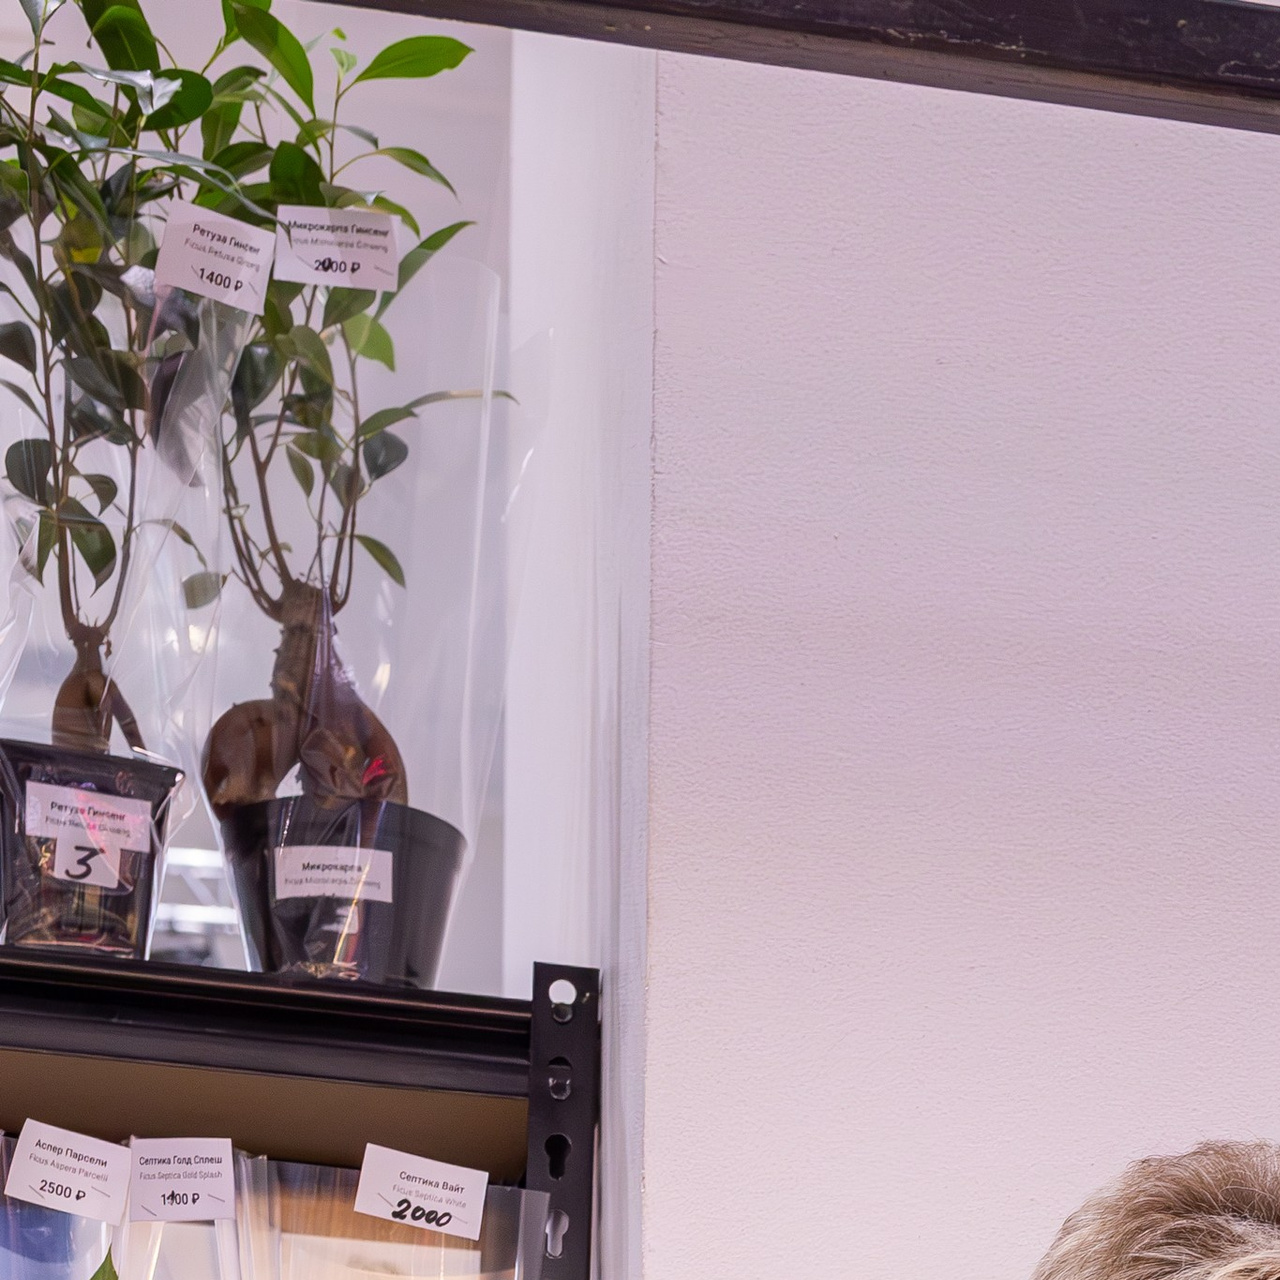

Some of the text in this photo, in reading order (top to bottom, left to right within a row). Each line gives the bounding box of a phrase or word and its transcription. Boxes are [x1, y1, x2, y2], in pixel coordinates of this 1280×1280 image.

[192, 223, 260, 255] Ретуза Гинсенг
[350, 224, 389, 237] Гинсенг
[199, 267, 231, 289] 1400
[65, 845, 103, 879] 3
[29, 1153, 49, 1165] Ficus
[50, 1160, 77, 1174] Aspera
[34, 1139, 107, 1168] Аспер Парсели
[139, 1155, 222, 1165] Септика Голд Сплеш
[39, 1179, 72, 1198] 2500
[399, 1171, 465, 1194] Септика Вайт
[391, 1198, 452, 1227] 2000
